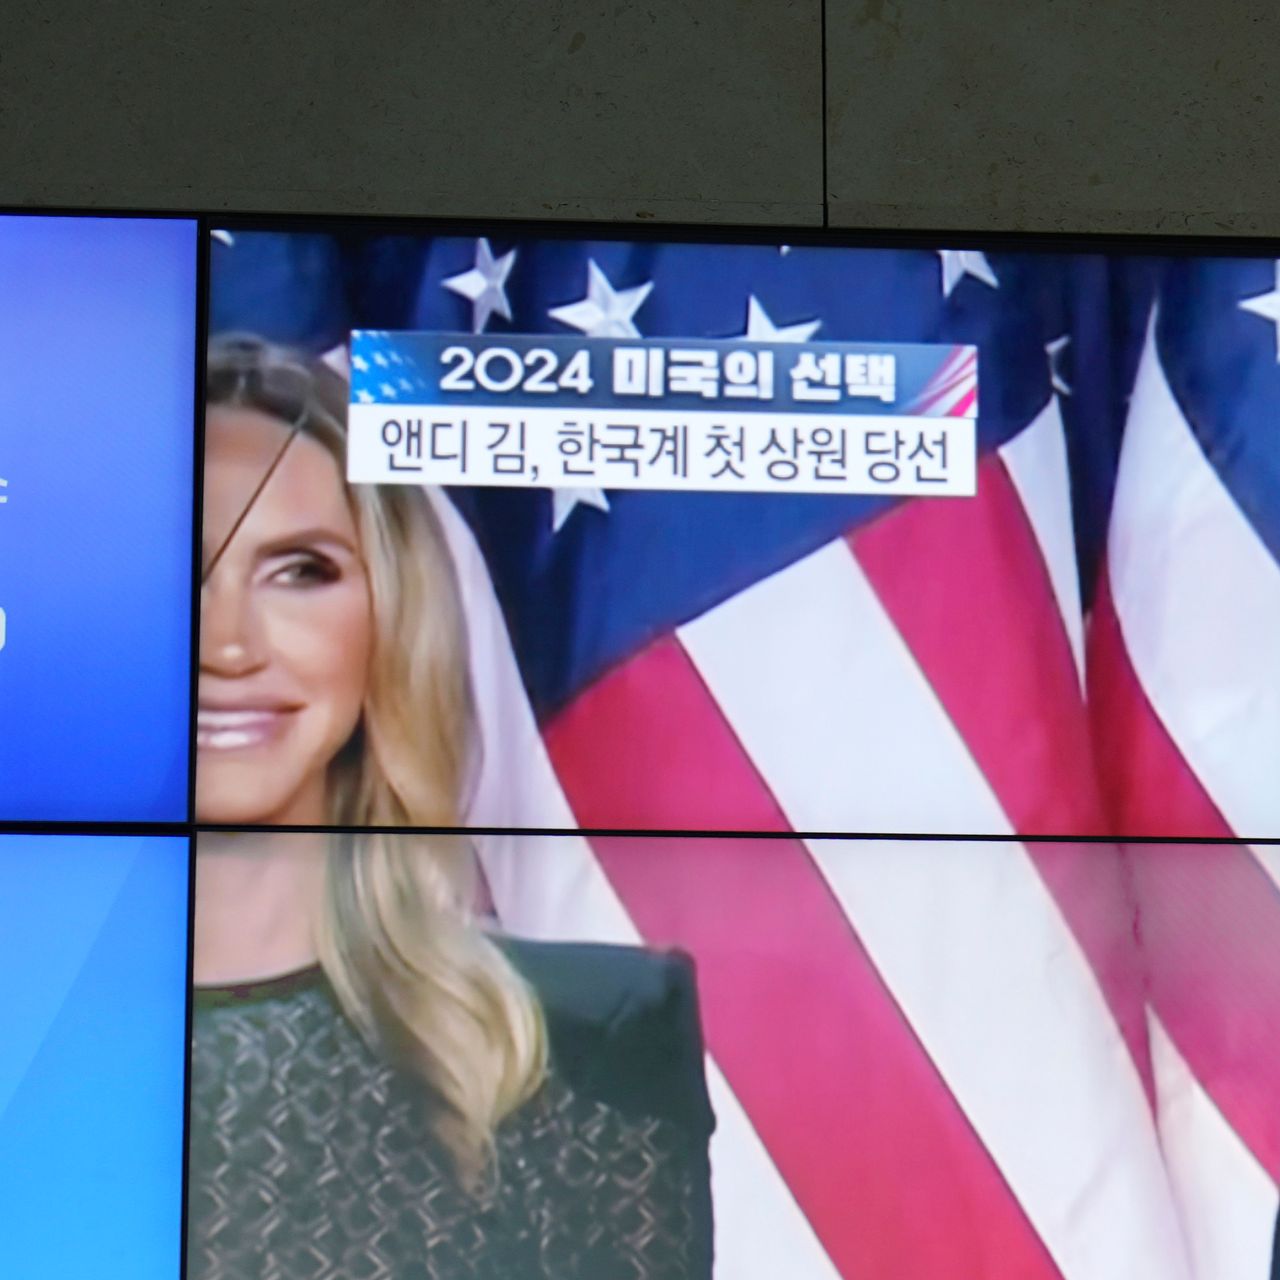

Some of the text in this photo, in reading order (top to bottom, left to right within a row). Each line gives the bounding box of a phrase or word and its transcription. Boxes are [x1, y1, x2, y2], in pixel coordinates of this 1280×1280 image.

[439, 346, 897, 403] 2024 미국의 선택
[380, 418, 948, 484] 앤디 김, 한국계 첫 상원 당선
